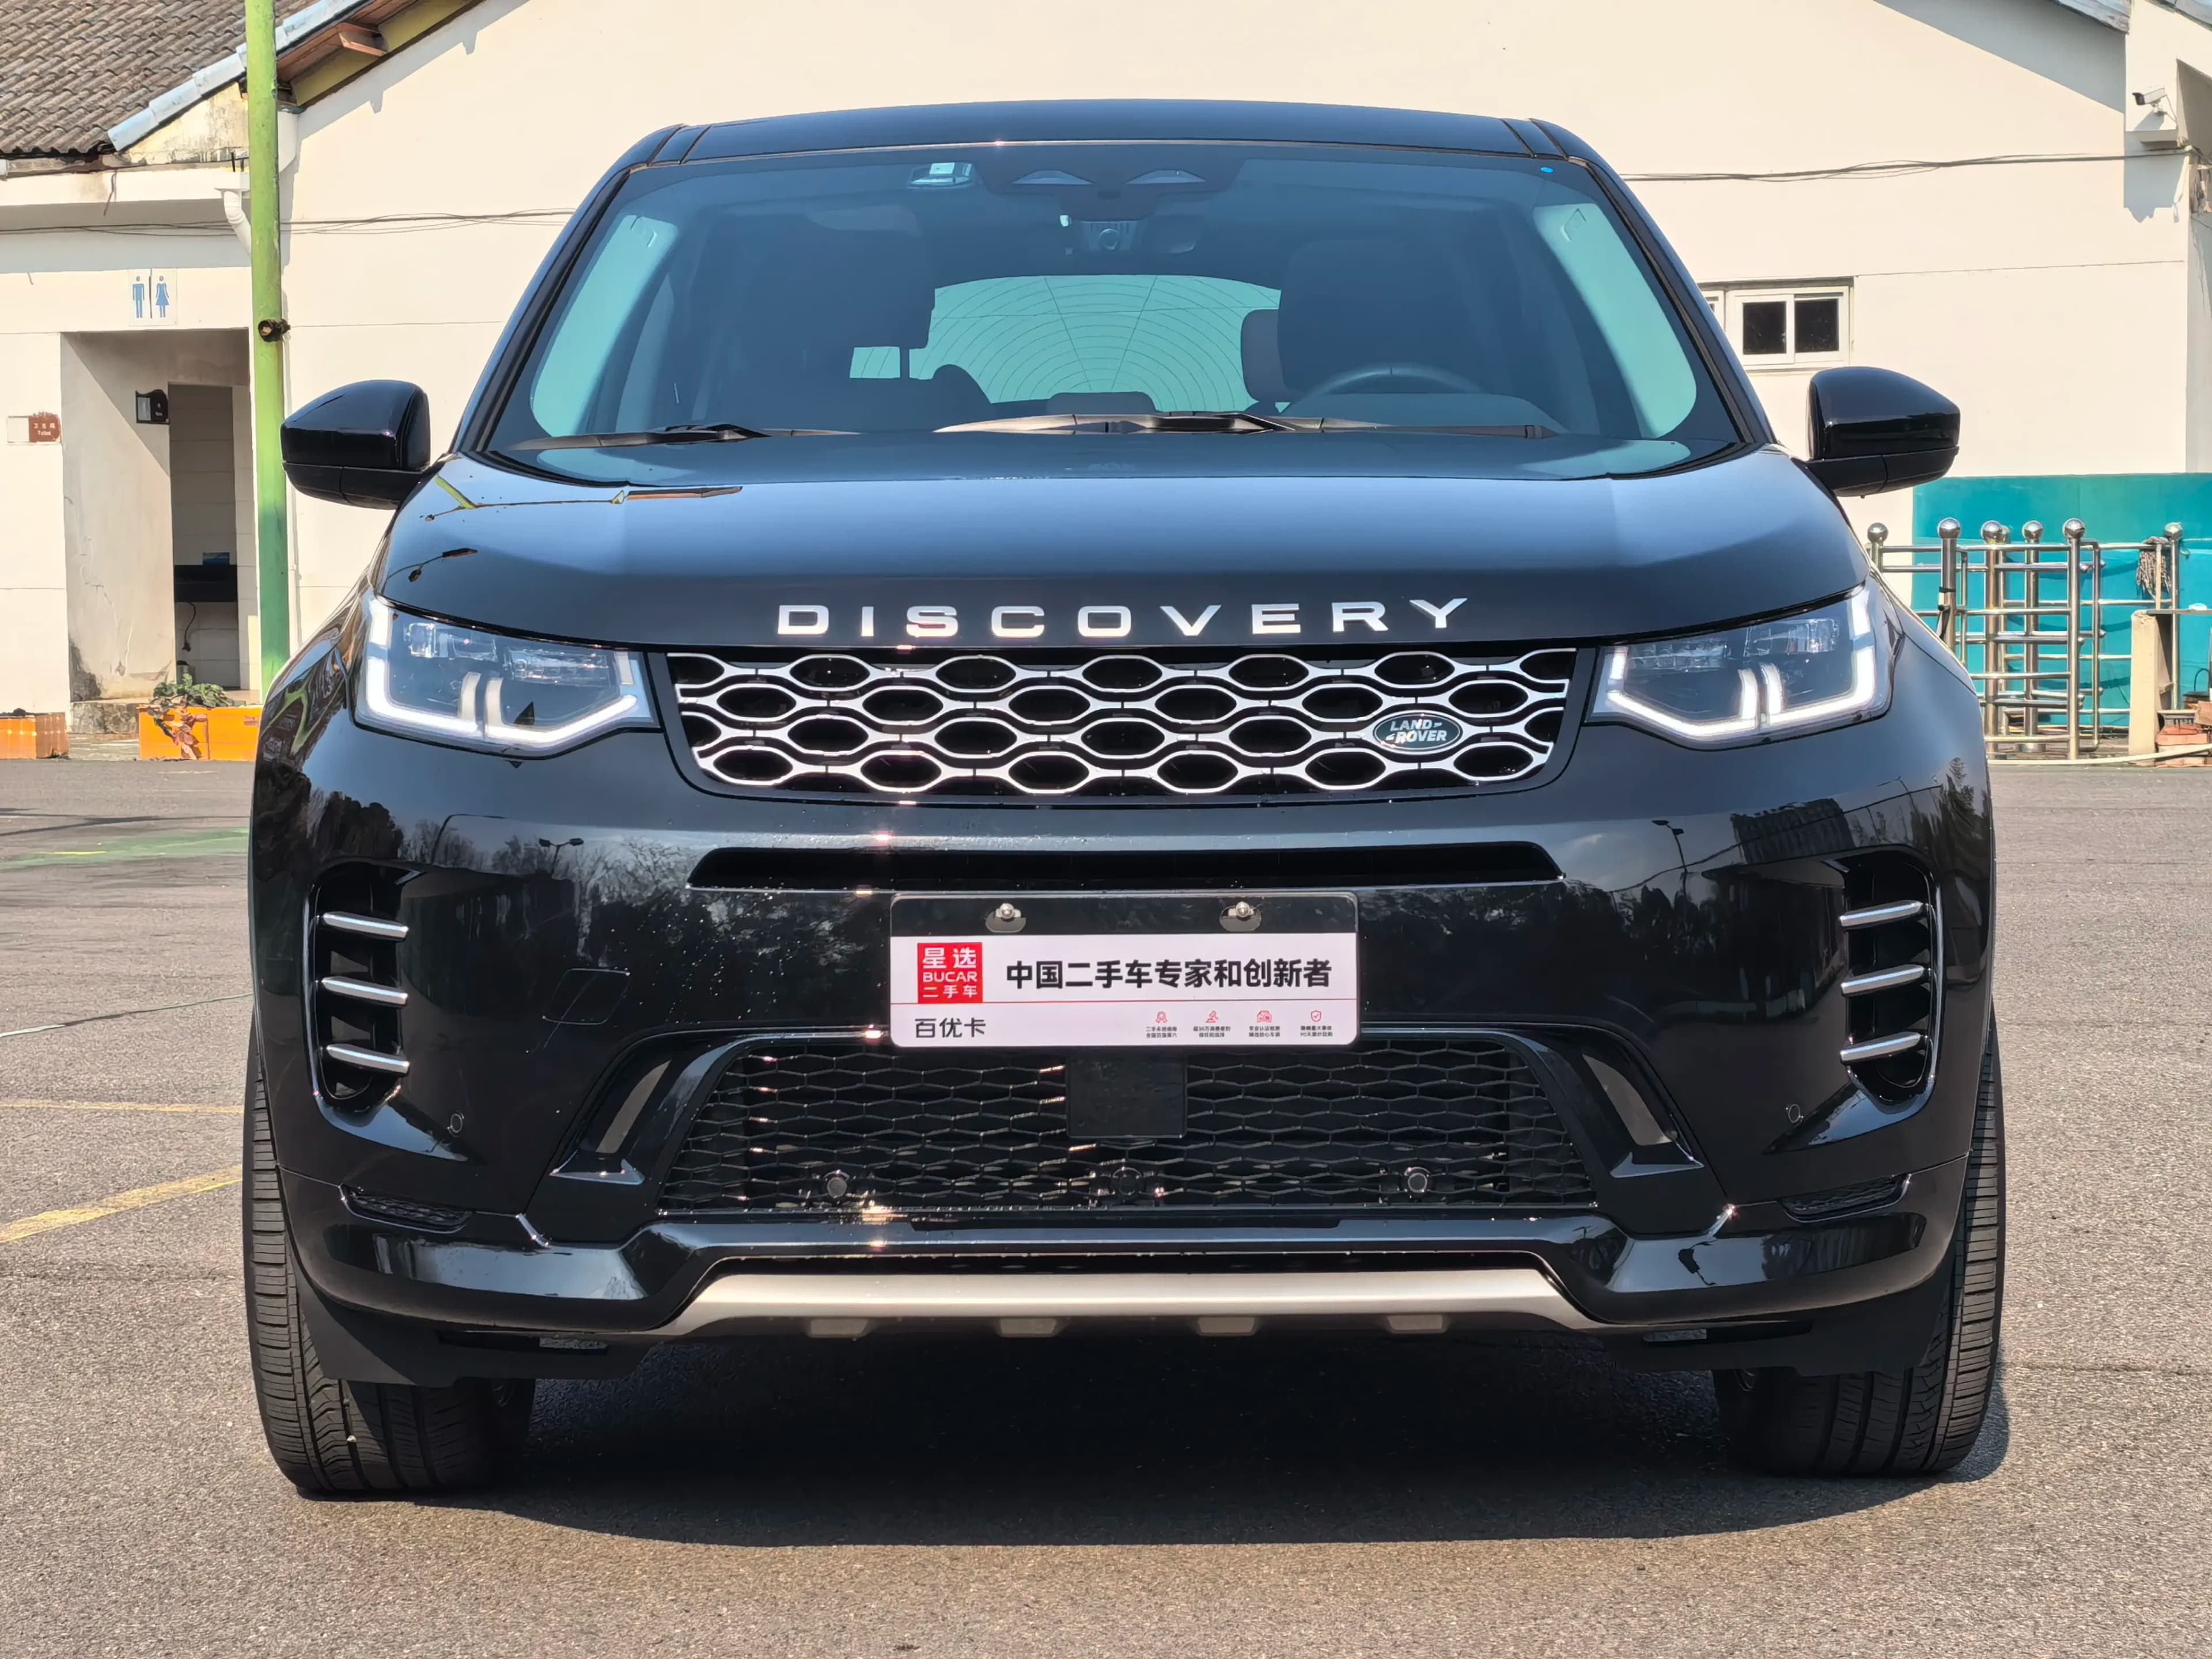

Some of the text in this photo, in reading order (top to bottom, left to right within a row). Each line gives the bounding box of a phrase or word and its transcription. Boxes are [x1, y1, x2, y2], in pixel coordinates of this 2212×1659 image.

[777, 598, 1468, 638] DISCOVERY
[1395, 730, 1448, 744] ROVER
[922, 946, 977, 969] 星选
[923, 971, 978, 983] BUCAR
[1006, 958, 1332, 990] 中国二手车专家和创新者
[923, 984, 978, 999] 二手车
[914, 1017, 987, 1038] 百优卡
